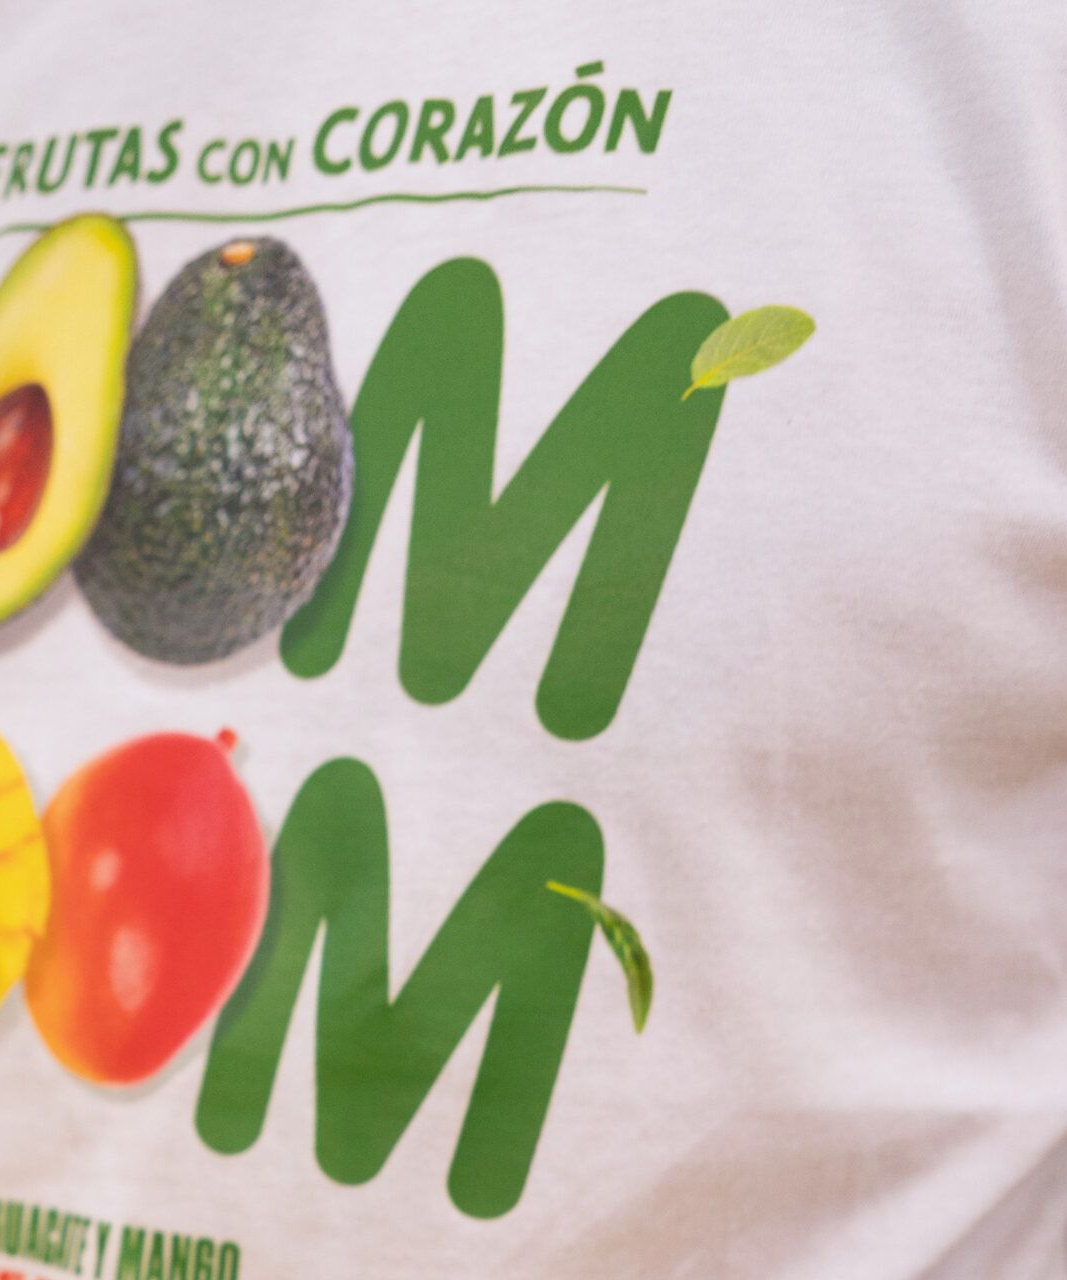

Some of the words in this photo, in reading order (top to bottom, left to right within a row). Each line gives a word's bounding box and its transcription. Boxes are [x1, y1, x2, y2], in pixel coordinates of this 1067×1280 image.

[197, 138, 294, 186] CON
[312, 60, 673, 176] CORAZÓN
[95, 1221, 112, 1279] Y
